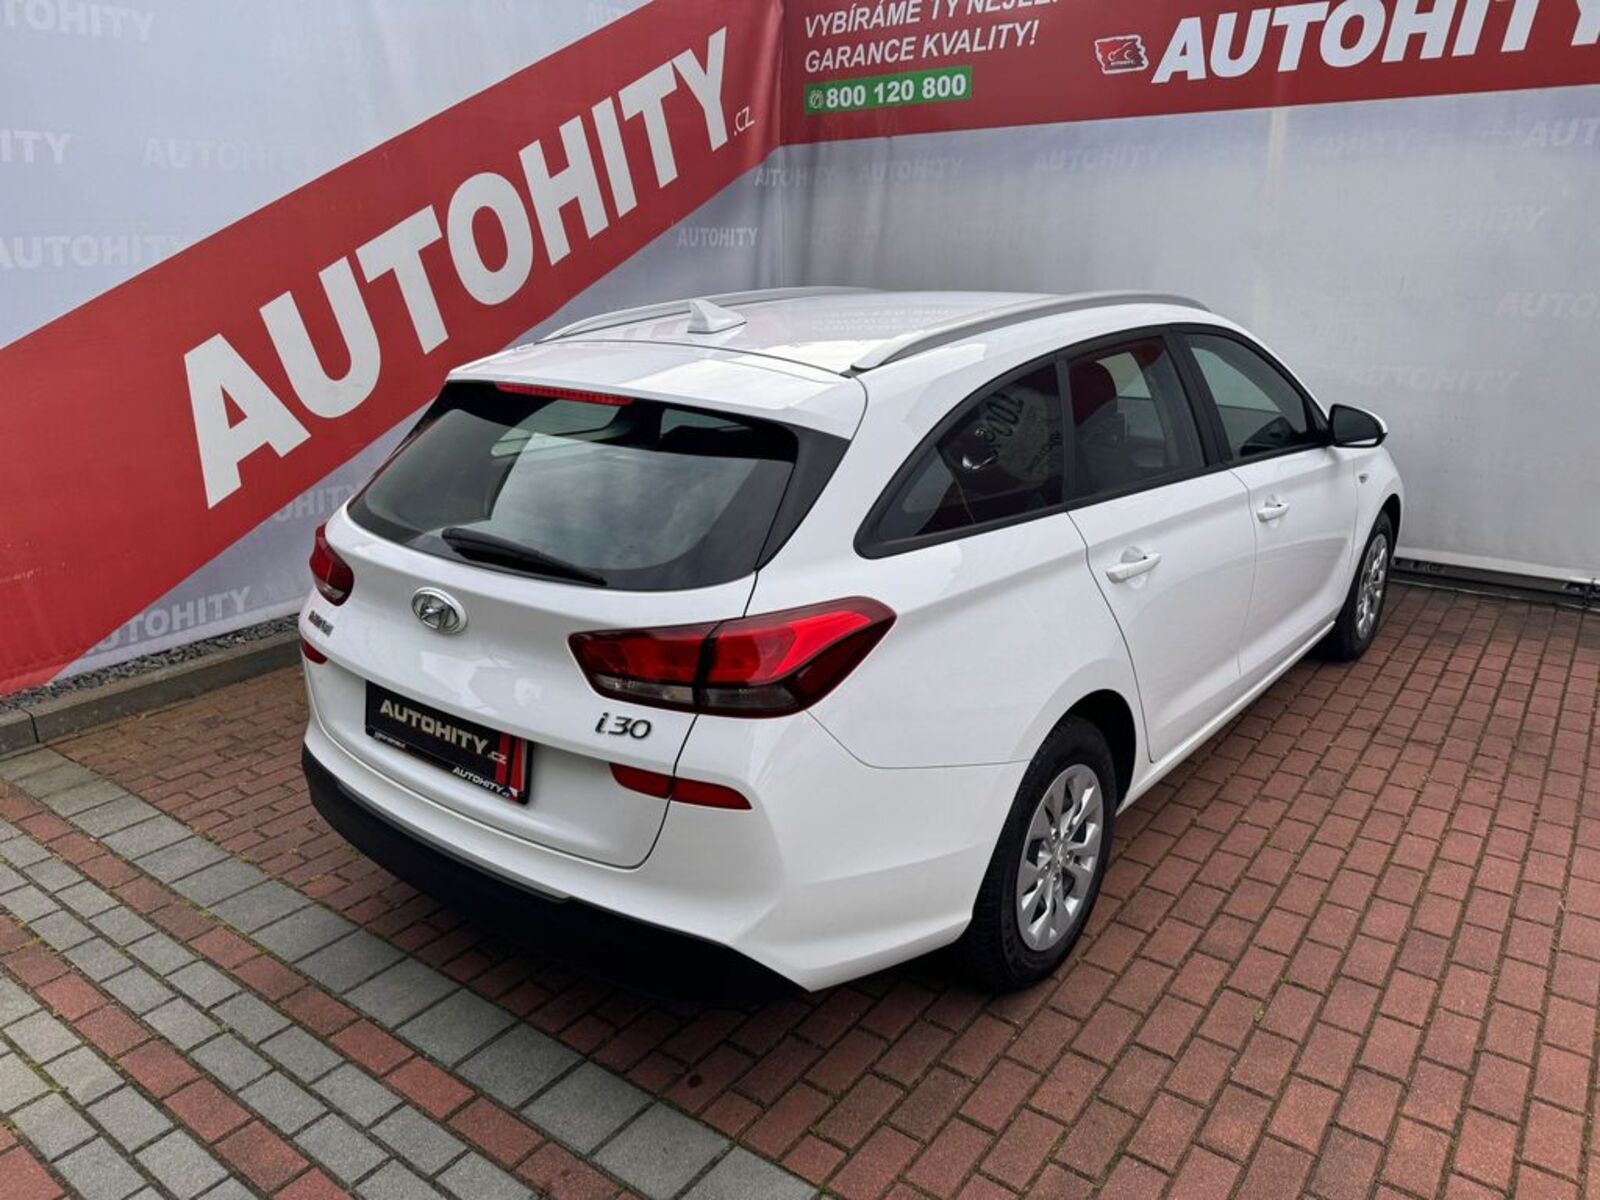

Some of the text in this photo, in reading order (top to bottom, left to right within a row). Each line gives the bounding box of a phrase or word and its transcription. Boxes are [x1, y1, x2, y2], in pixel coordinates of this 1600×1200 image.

[805, 0, 922, 38] VYBÍRÁME
[805, 19, 1040, 73] GARANCE KVALITY!
[826, 74, 966, 108] 800 120 800
[677, 226, 759, 249] AUTOHITY
[595, 712, 652, 739] i30
